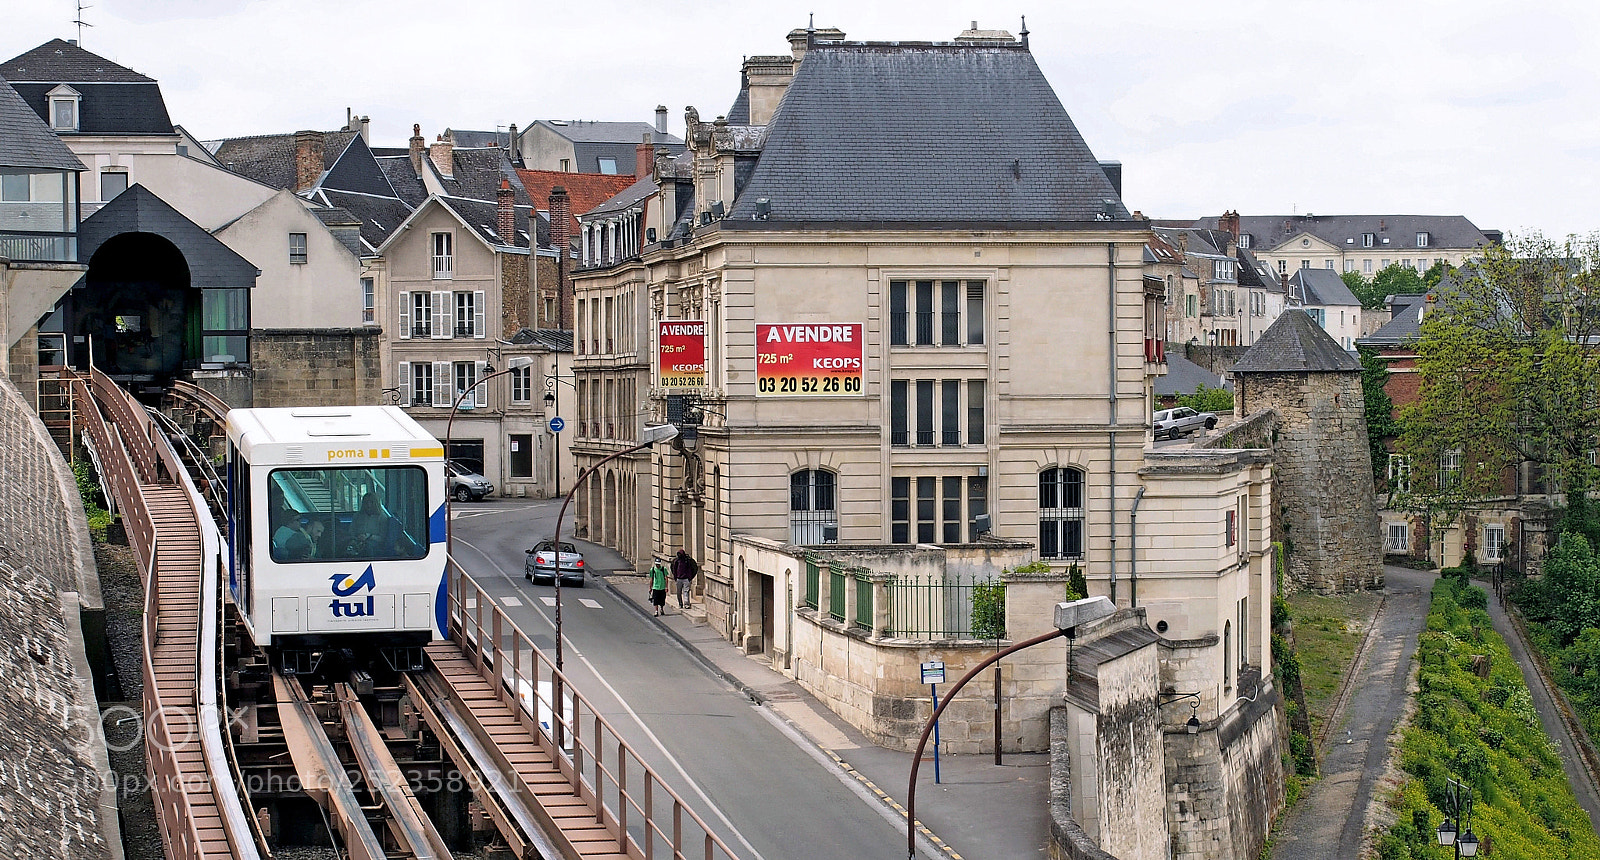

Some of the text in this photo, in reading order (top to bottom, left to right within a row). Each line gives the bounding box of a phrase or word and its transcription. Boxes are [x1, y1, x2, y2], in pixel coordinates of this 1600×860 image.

[661, 325, 704, 336] A VENDRE
[767, 326, 852, 342] A VENDRE
[661, 345, 674, 353] 725
[758, 353, 777, 364] 725
[813, 358, 861, 368] KEOPS
[661, 377, 704, 386] 03 20 52 26 60
[759, 377, 860, 392] 03 20 52 26 60
[327, 449, 364, 461] poma
[328, 595, 374, 617] tul
